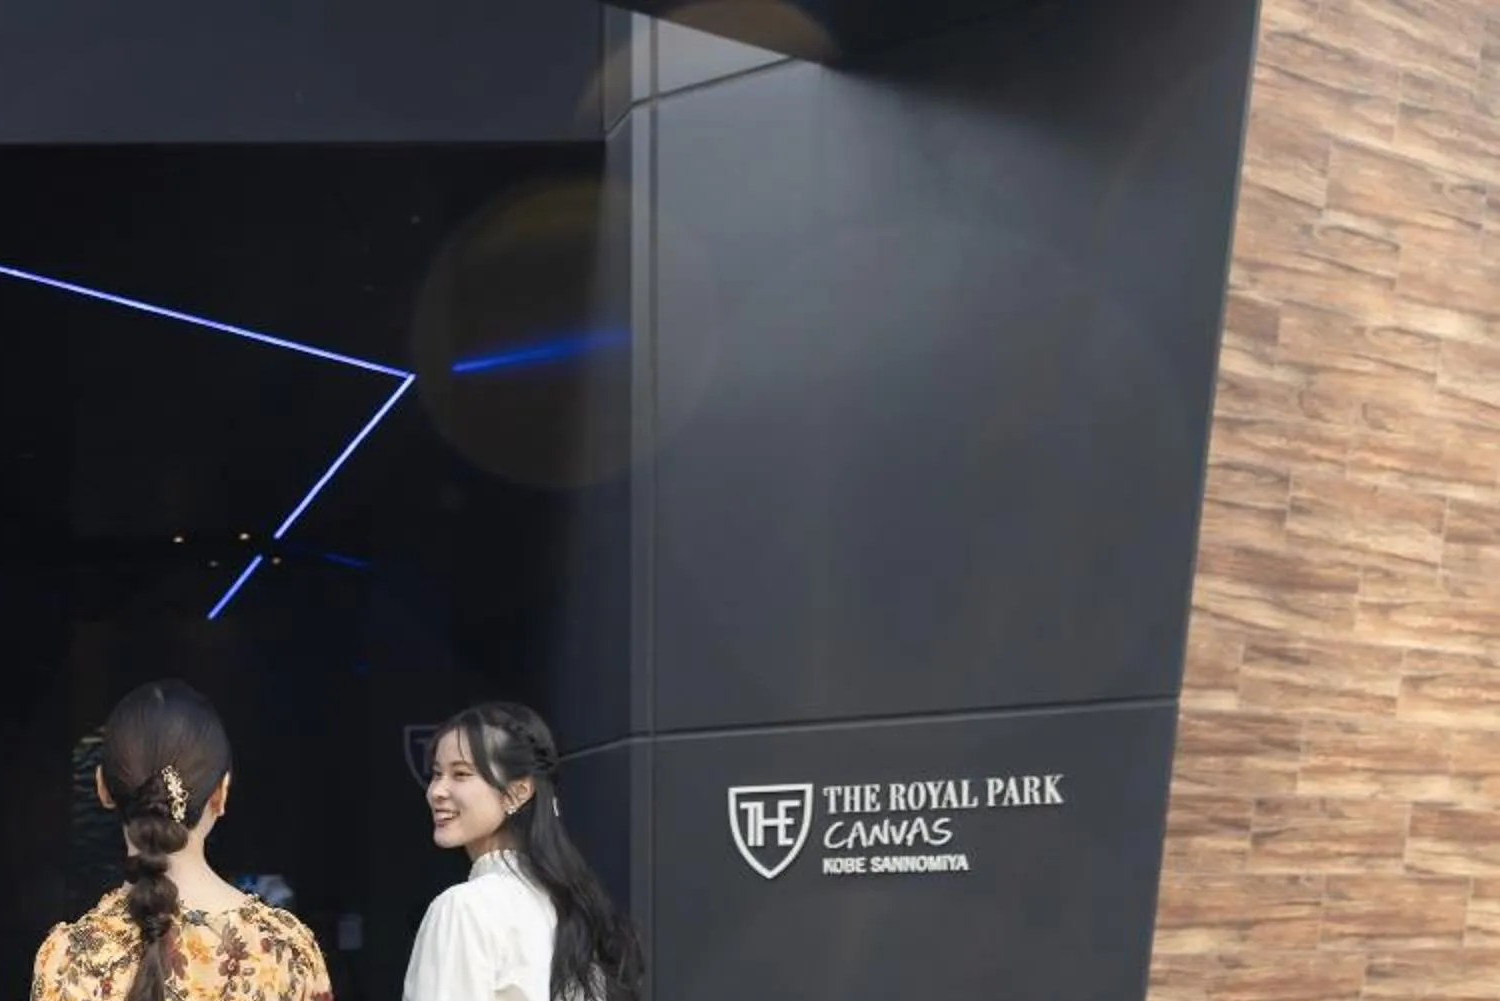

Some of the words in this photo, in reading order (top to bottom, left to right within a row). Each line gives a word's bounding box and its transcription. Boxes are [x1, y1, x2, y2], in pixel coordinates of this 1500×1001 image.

[823, 785, 881, 813] THE
[889, 778, 979, 811] ROYAL
[986, 774, 1064, 807] PARK
[740, 800, 802, 847] THE
[823, 817, 953, 849] CANVAS
[823, 856, 867, 874] KOBE
[870, 854, 969, 873] SANNOMIYA
